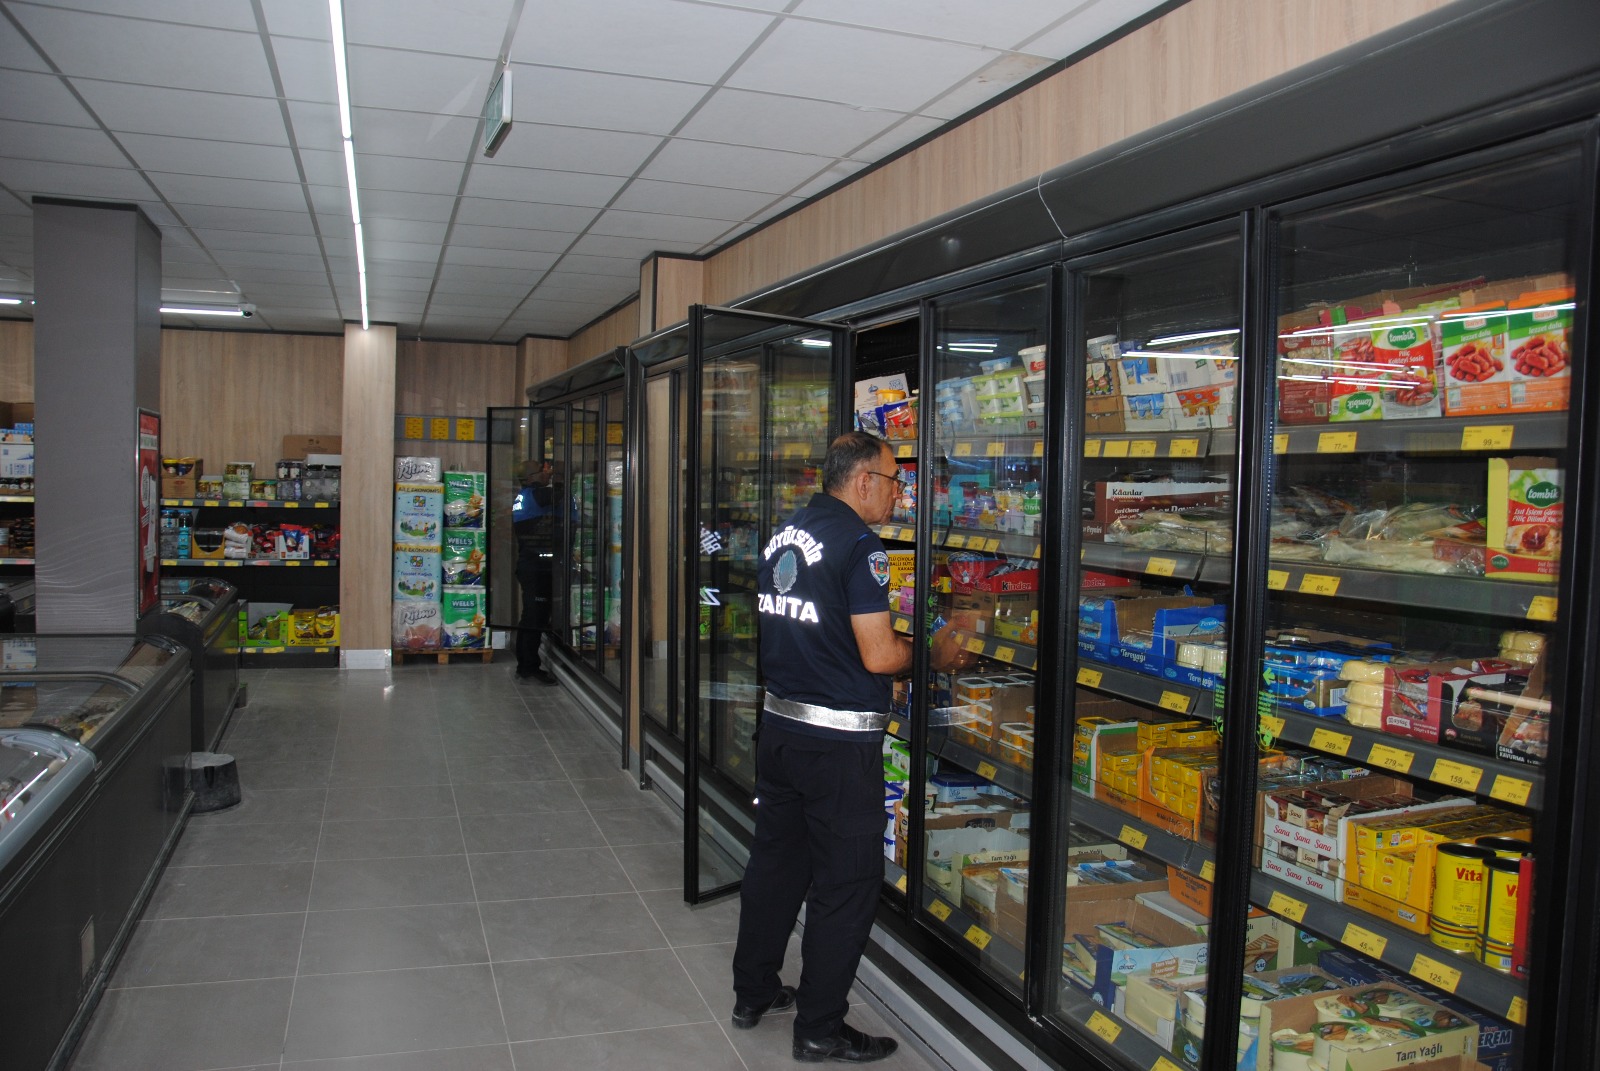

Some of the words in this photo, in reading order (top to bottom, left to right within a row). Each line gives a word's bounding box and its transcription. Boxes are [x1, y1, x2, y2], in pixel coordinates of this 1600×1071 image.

[1388, 329, 1415, 342] tombik
[1478, 330, 1491, 338] dolu
[1528, 488, 1559, 499] tombik
[1002, 580, 1032, 591] Kinder
[757, 593, 820, 624] ZABITA
[1120, 648, 1146, 663] Tereyağı
[1499, 752, 1525, 763] KAVURMA
[1273, 824, 1291, 838] Sana
[1293, 831, 1311, 845] Sana
[1314, 839, 1332, 852] Sana
[1266, 859, 1282, 873] Sana
[1285, 867, 1302, 881] Sana
[1305, 876, 1324, 890] Sana
[1456, 867, 1482, 882] Vita
[1396, 1050, 1417, 1062] Tam
[1420, 1042, 1443, 1058] Yağlı
